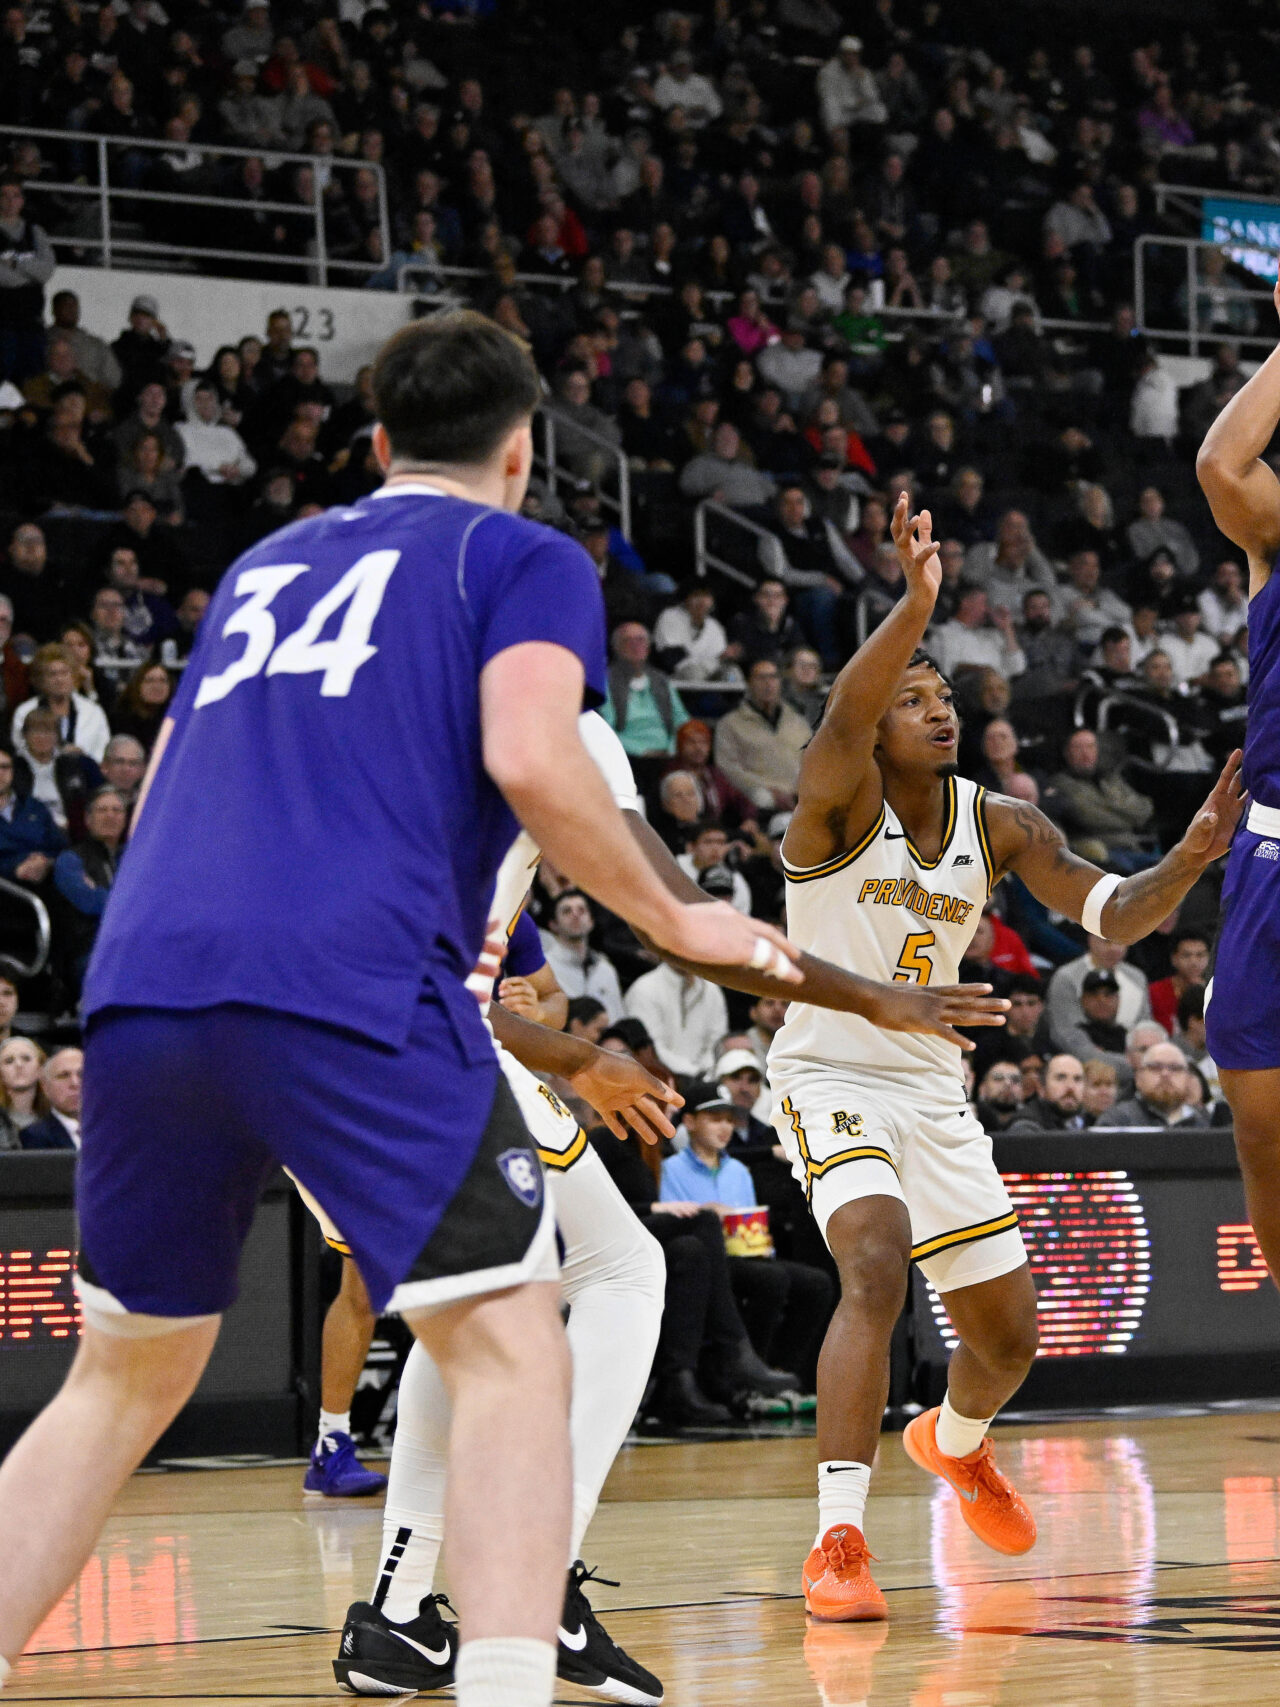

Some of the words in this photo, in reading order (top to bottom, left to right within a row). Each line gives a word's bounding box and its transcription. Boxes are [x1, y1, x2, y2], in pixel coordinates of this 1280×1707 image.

[193, 549, 402, 710] 34
[857, 877, 975, 925] PROVIDENCE
[892, 930, 936, 986] 5
